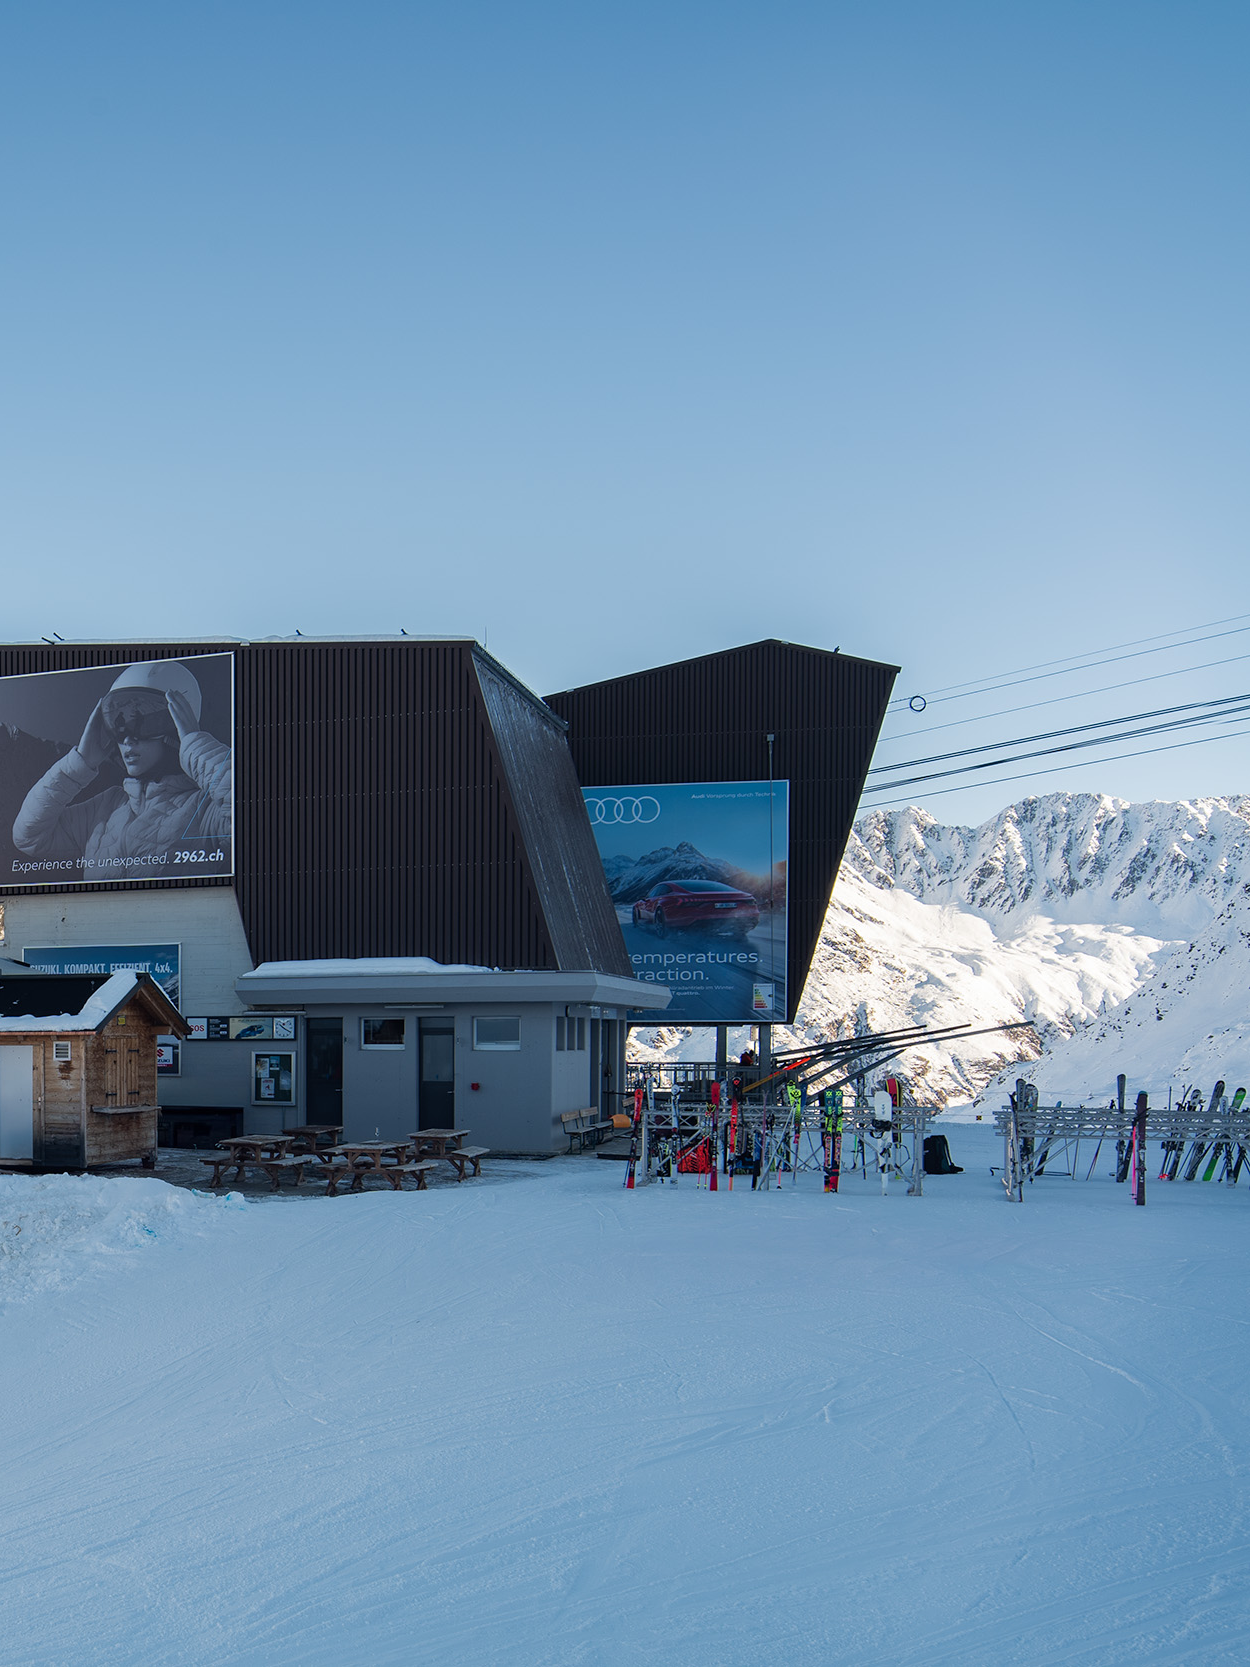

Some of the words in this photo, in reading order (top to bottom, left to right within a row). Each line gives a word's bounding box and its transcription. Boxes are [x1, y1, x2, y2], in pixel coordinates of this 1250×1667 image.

[11, 858, 73, 874] Experience
[75, 856, 95, 869] the
[97, 852, 170, 869] unexpected.
[173, 849, 225, 864] 2962.ch
[628, 951, 763, 966] emperatures.
[64, 963, 108, 975] KOMPAKT.
[154, 962, 173, 974] 4x4.
[633, 967, 710, 981] raction.
[191, 1024, 205, 1032] SOS
